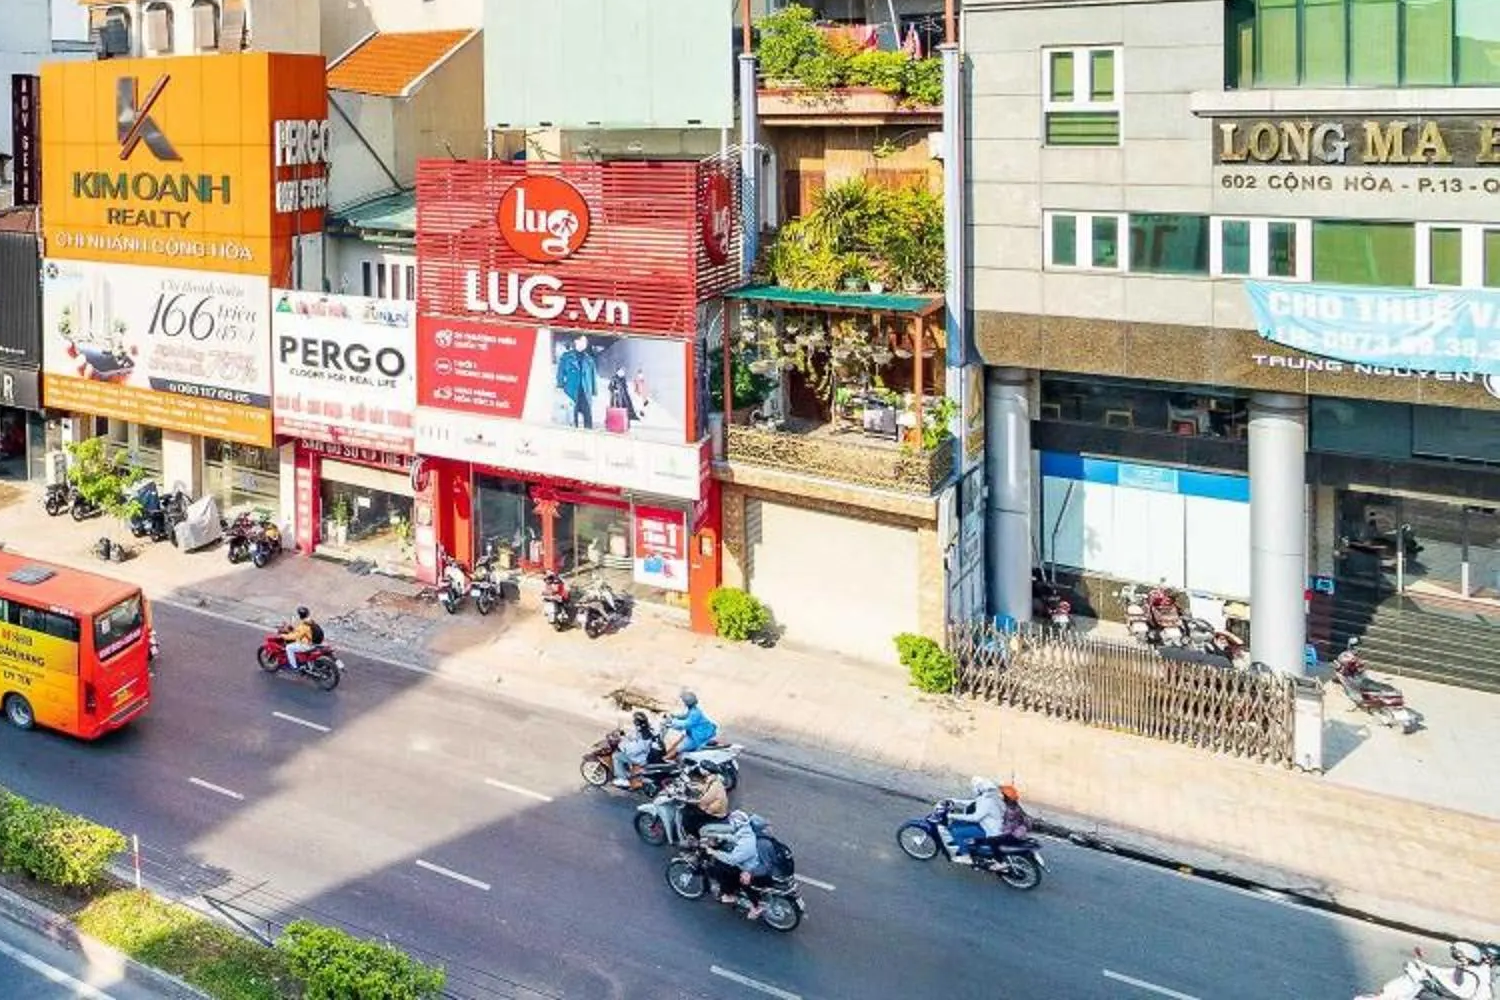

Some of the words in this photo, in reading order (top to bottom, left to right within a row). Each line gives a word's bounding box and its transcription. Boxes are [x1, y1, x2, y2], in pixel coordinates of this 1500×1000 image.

[1219, 119, 1349, 163] LONG
[1362, 119, 1453, 164] MA
[1221, 174, 1257, 190] 602
[1267, 170, 1333, 193] CỘNG
[1344, 171, 1394, 193] HÒA
[1417, 178, 1463, 194] P.13
[107, 207, 192, 228] REALTY
[514, 187, 579, 256] lug
[147, 293, 215, 341] 166
[463, 269, 630, 326] LUG.vn
[1268, 290, 1343, 319] CHO
[279, 335, 405, 377] PERGO
[1251, 354, 1342, 372] TRUNG
